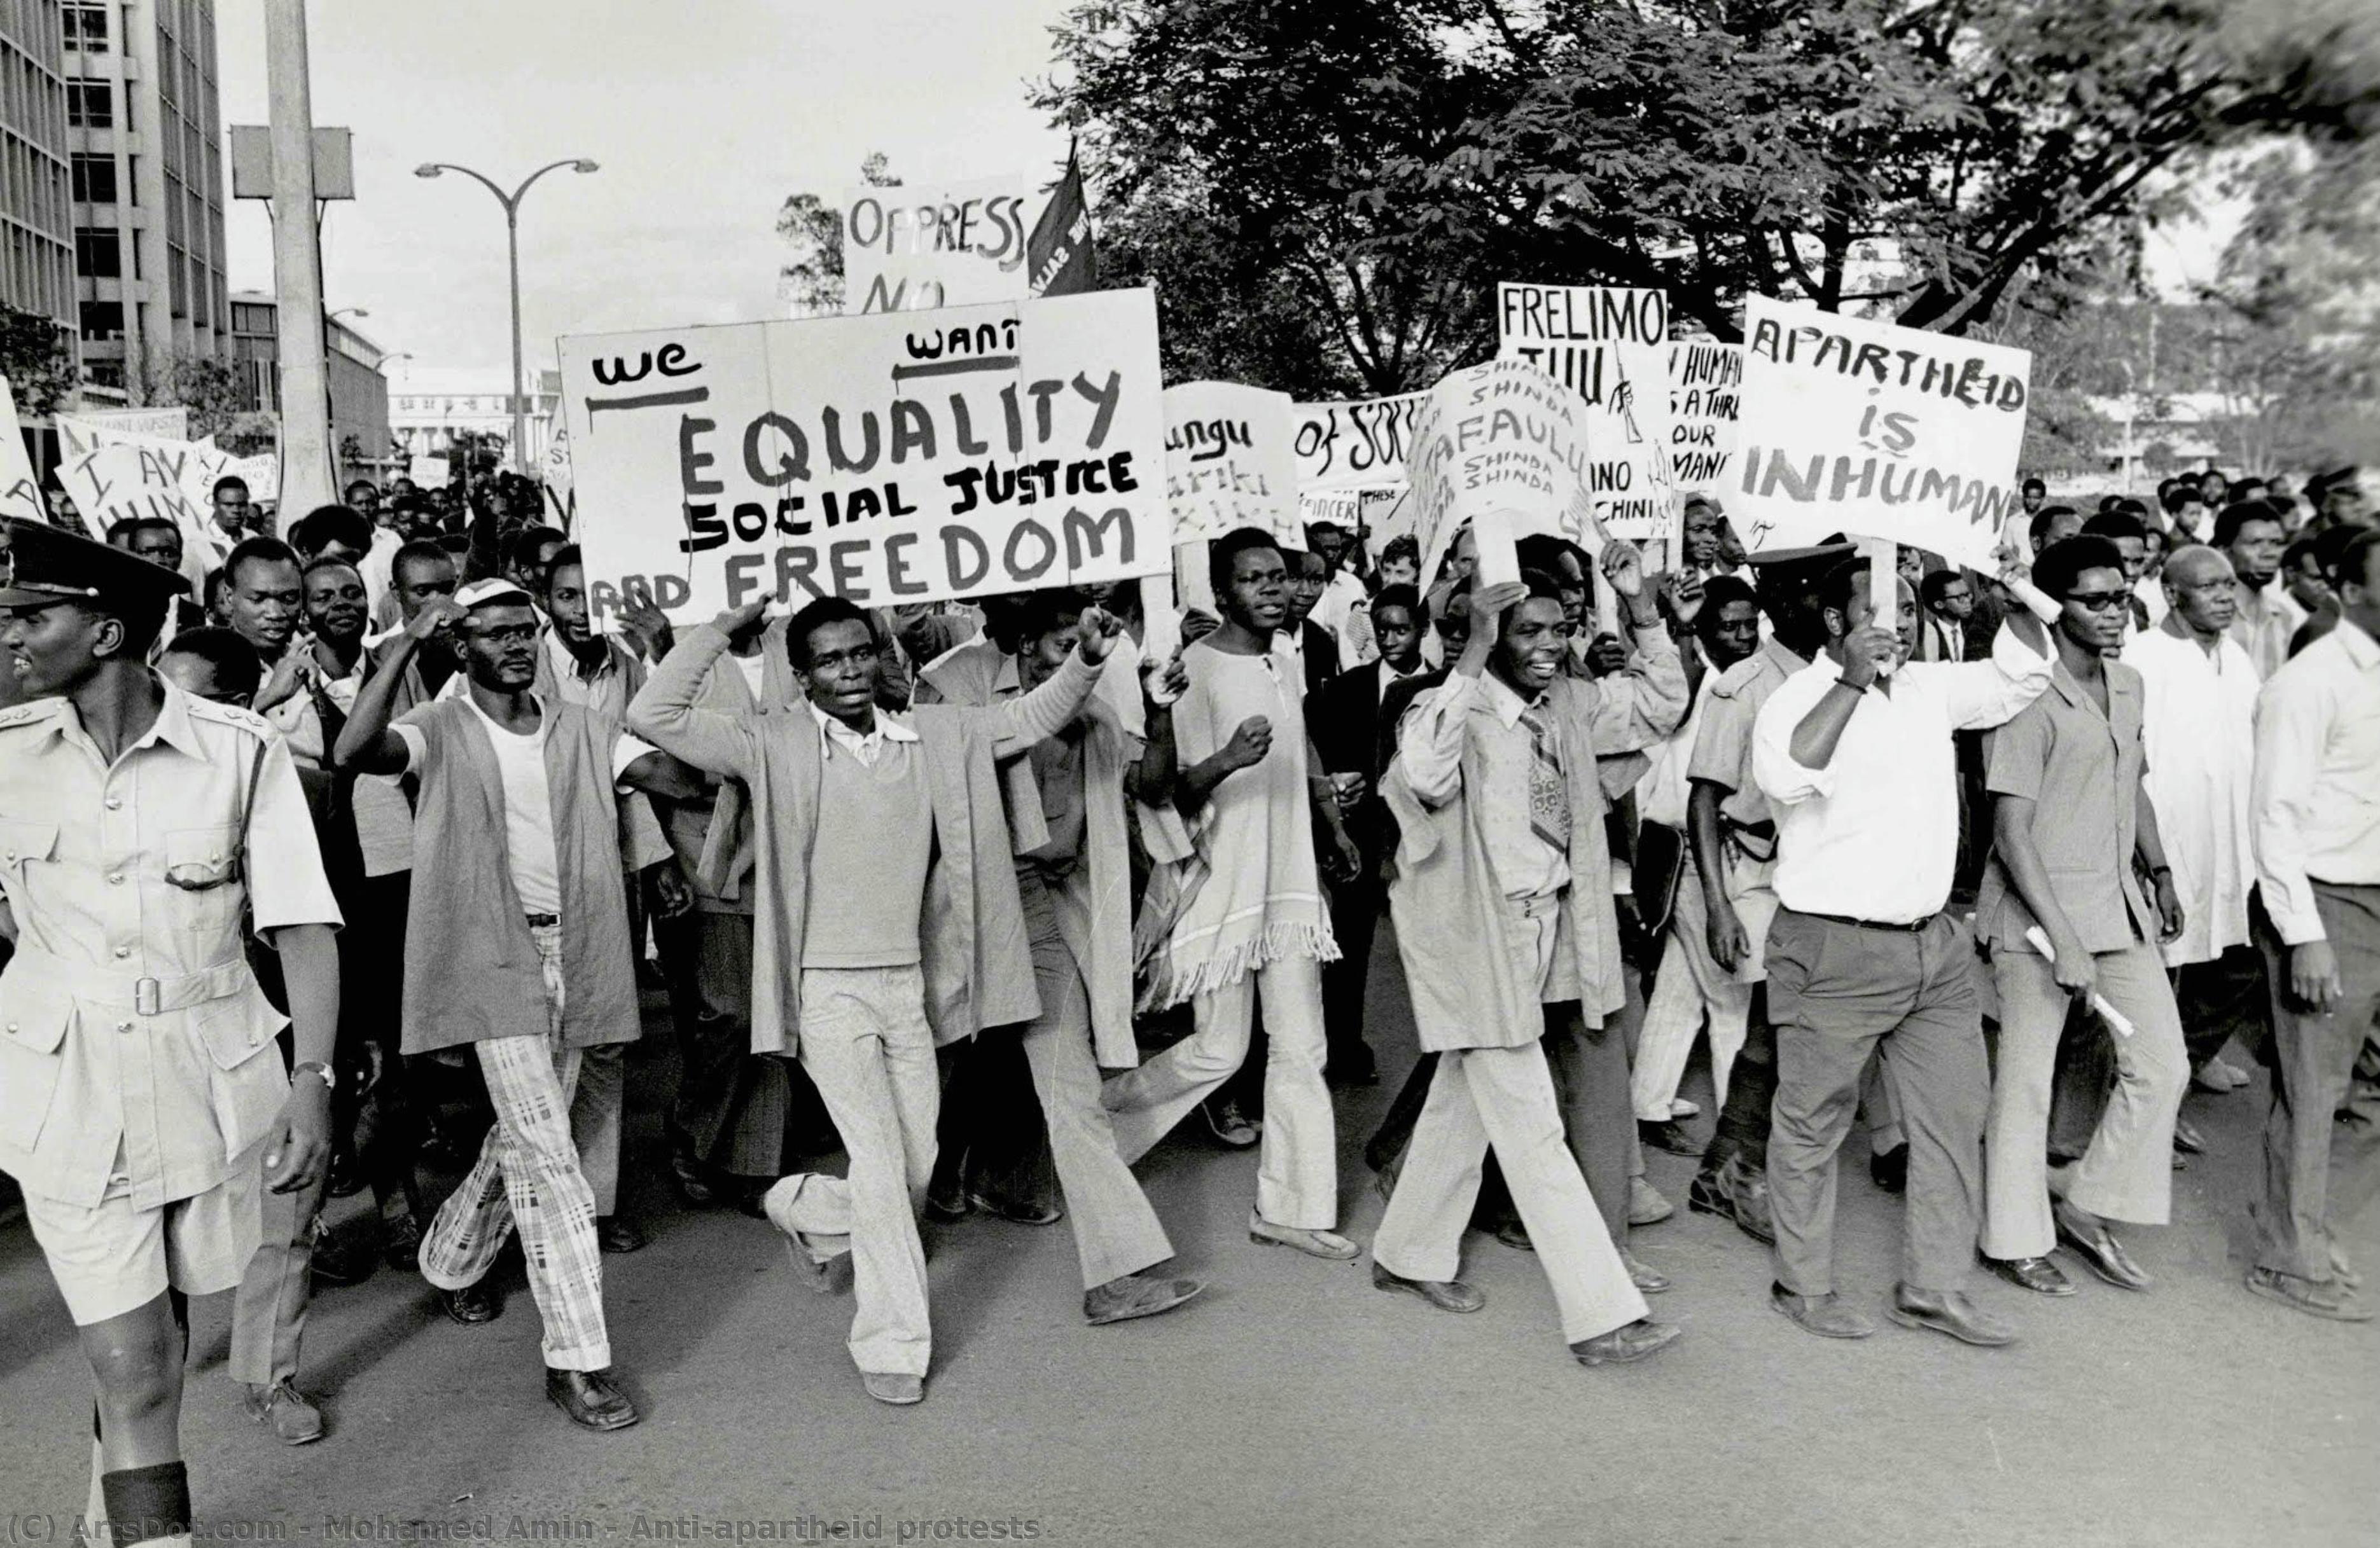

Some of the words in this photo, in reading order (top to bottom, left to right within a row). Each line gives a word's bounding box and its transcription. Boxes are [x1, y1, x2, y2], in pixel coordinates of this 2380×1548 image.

[1503, 287, 1666, 346] FRELIMO
[1751, 317, 2026, 413] APARTHEID
[679, 370, 1122, 495] EQUALITY
[1469, 379, 1573, 427] SHINDA
[1672, 424, 1716, 447] OUR
[1463, 450, 1553, 476] SHINDA
[1464, 468, 1554, 496] SHINDA
[1741, 445, 2012, 534] INHUMAN
[679, 482, 917, 553] SOCIAL
[943, 451, 1139, 515] JUSTICE
[726, 507, 1136, 609] FREEDOM
